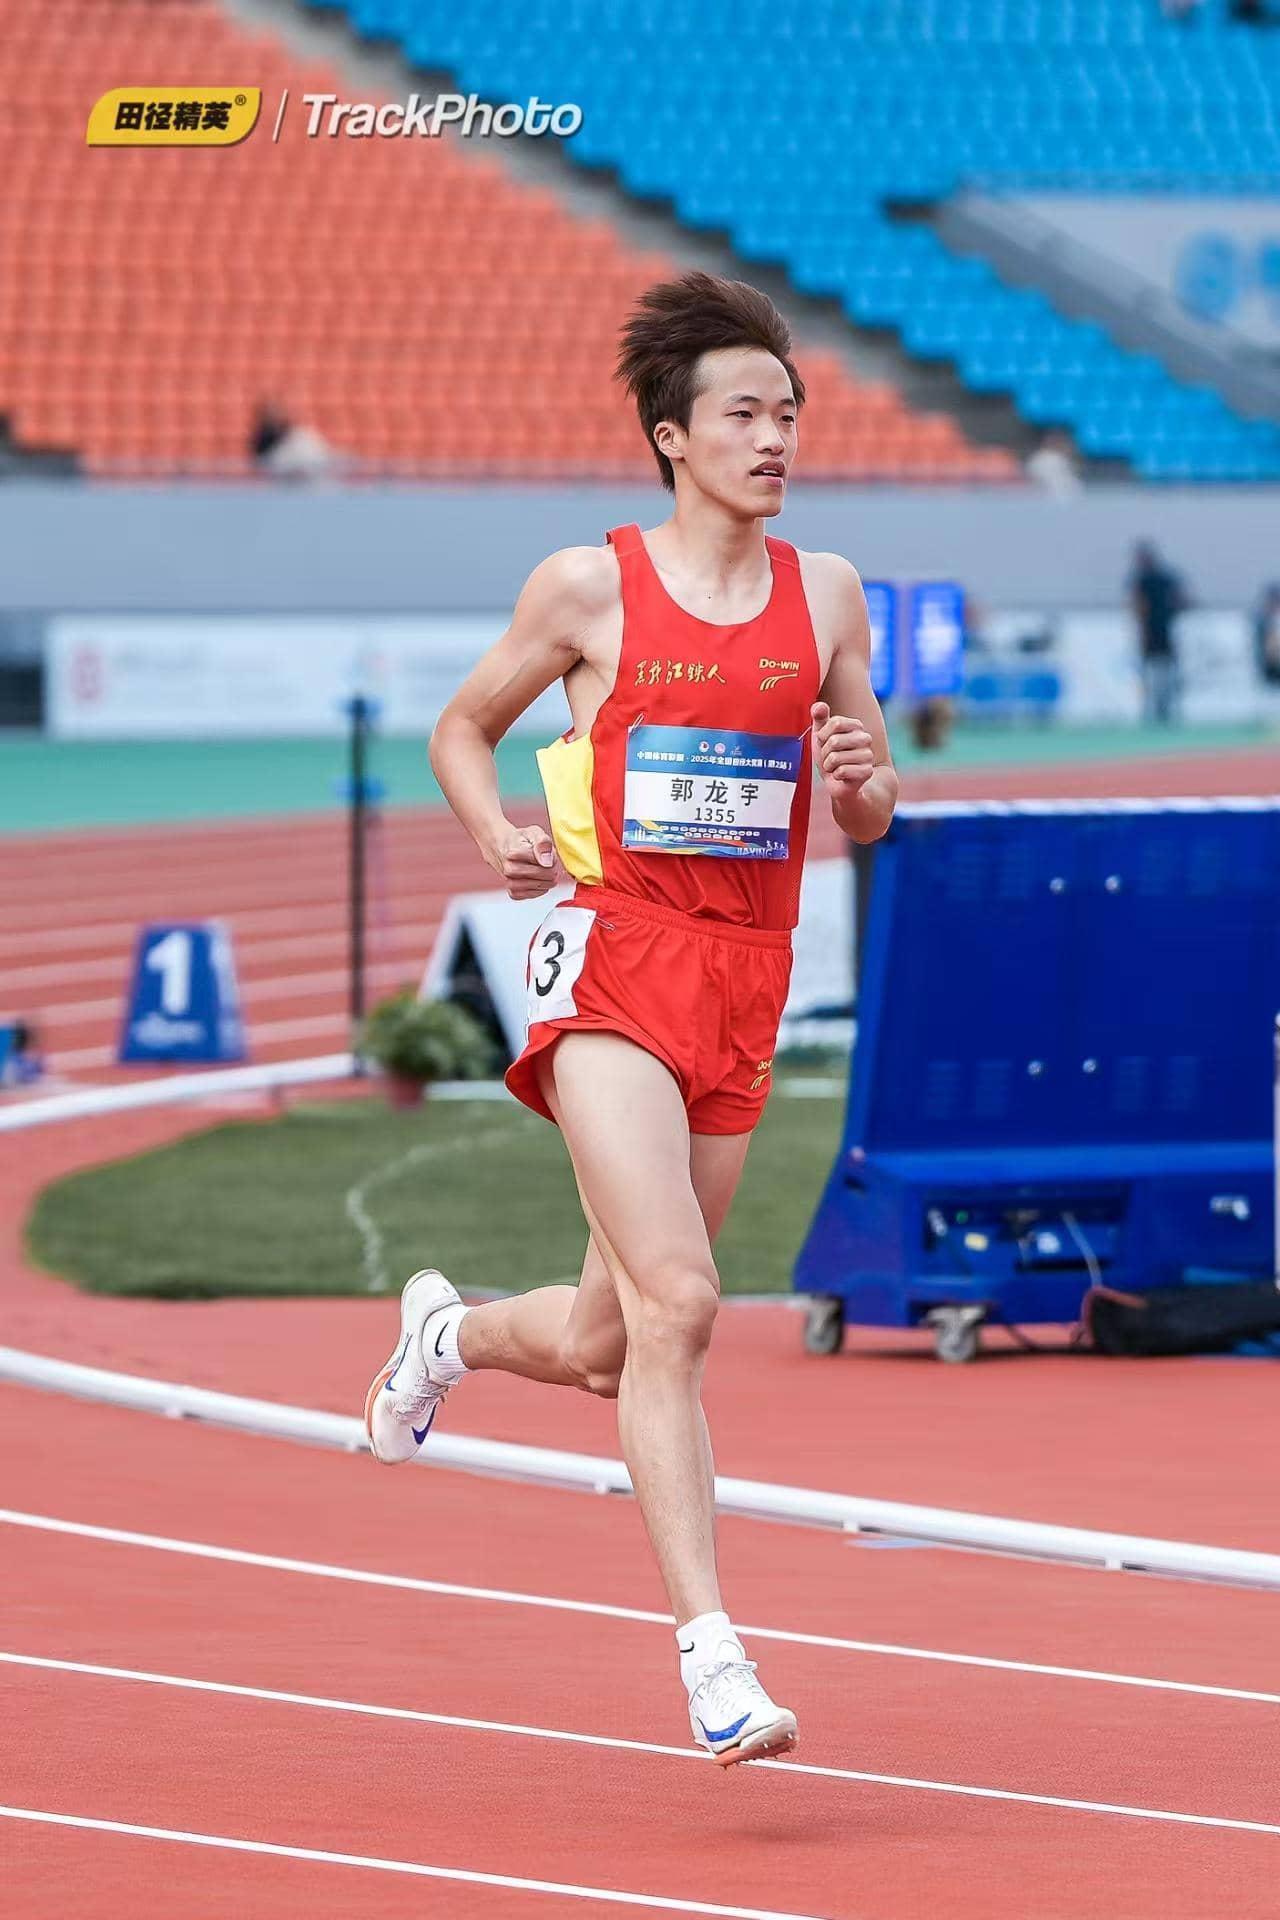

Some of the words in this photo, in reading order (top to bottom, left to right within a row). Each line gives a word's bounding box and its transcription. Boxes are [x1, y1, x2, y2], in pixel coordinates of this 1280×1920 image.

[670, 777, 759, 806] 郭龙宇
[694, 807, 736, 824] 1355
[145, 930, 192, 1015] 1
[535, 930, 565, 997] 3
